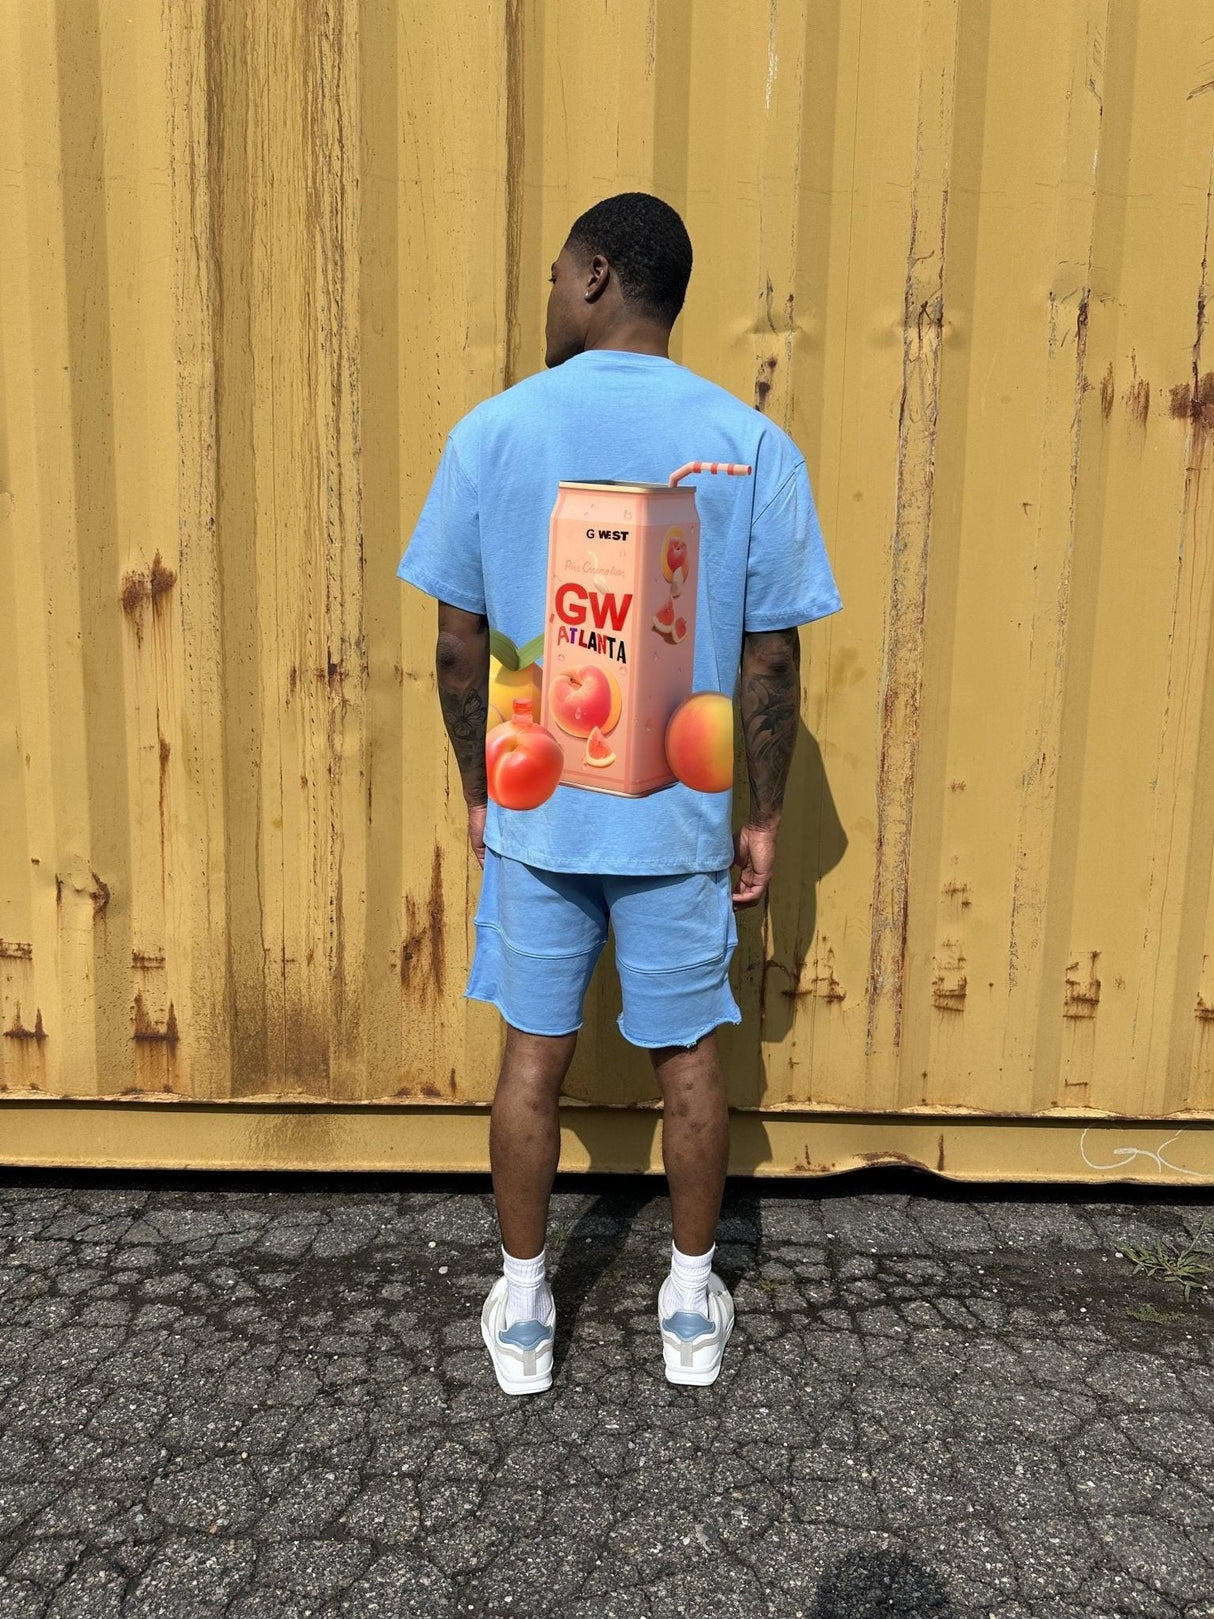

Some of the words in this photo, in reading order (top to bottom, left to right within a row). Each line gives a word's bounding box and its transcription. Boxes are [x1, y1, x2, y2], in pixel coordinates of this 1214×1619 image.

[586, 529, 595, 539] G
[598, 530, 629, 541] WEST
[555, 582, 633, 632] GW
[557, 626, 627, 664] ATLANTA
